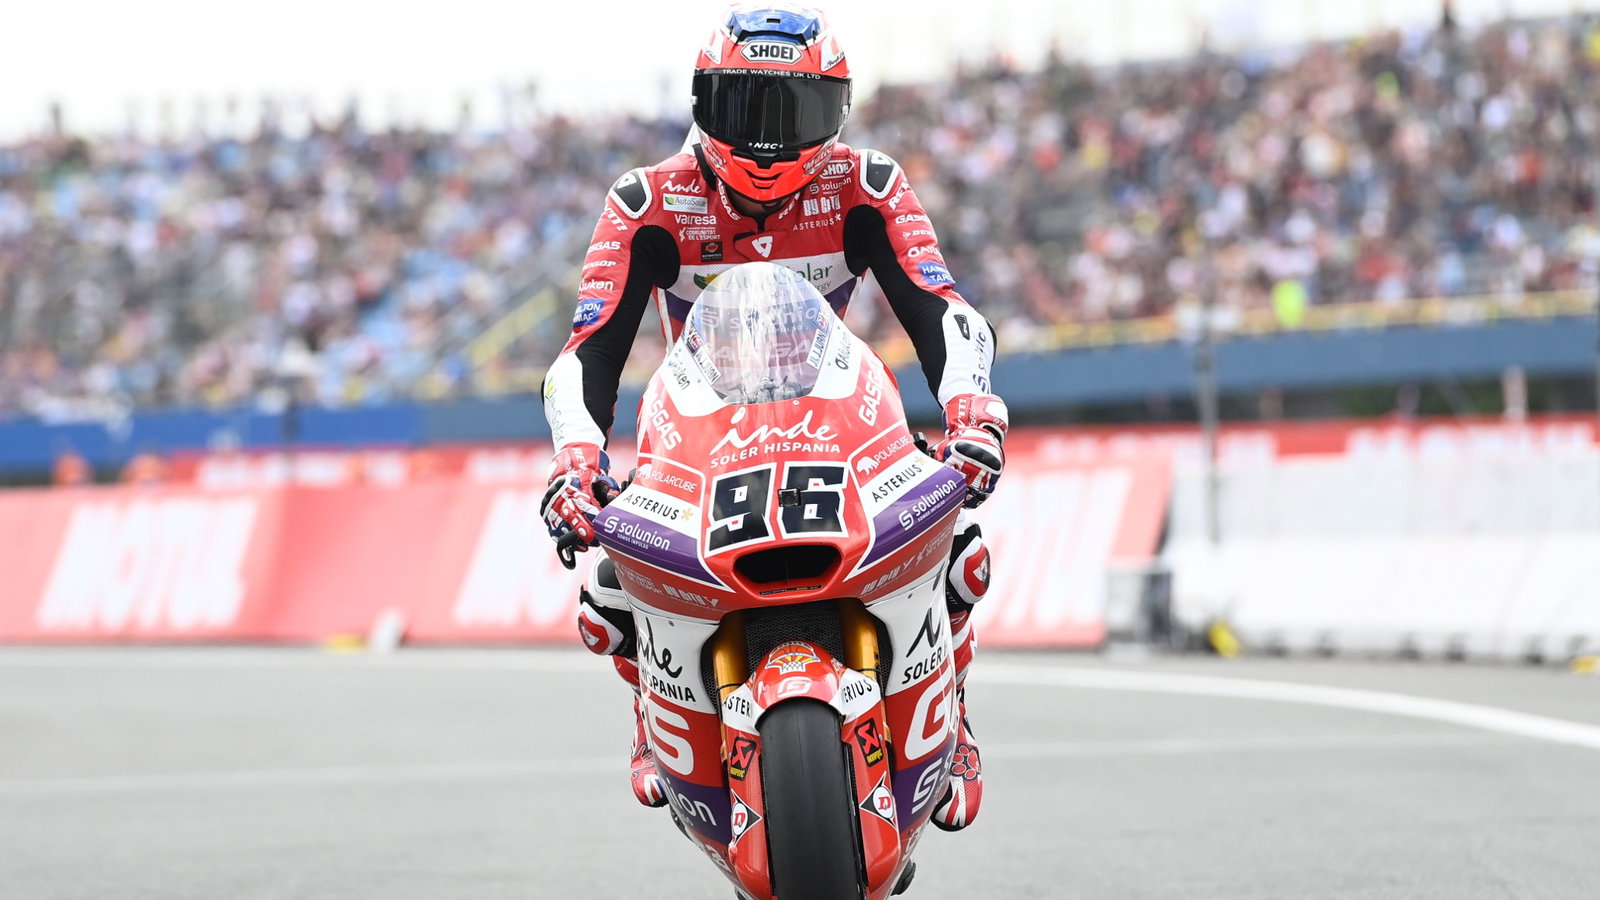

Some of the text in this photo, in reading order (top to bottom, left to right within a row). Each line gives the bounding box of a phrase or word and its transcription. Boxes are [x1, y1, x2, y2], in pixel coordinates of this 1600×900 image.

[749, 44, 794, 60] SHOEI
[750, 69, 791, 77] WATCHES
[753, 142, 779, 150] NSC
[793, 217, 835, 231] ASTERIUS
[709, 407, 838, 456] inde
[710, 442, 841, 469] SOLER HISPANIA
[873, 434, 912, 465] POLARCUBE
[651, 470, 698, 493] POLARCUBE
[871, 463, 923, 503] ASTERIUS
[622, 494, 680, 521] ASTERIUS
[706, 463, 849, 552] 96
[912, 478, 958, 517] solunion
[618, 521, 671, 552] solunion
[902, 646, 942, 685] SOLER
